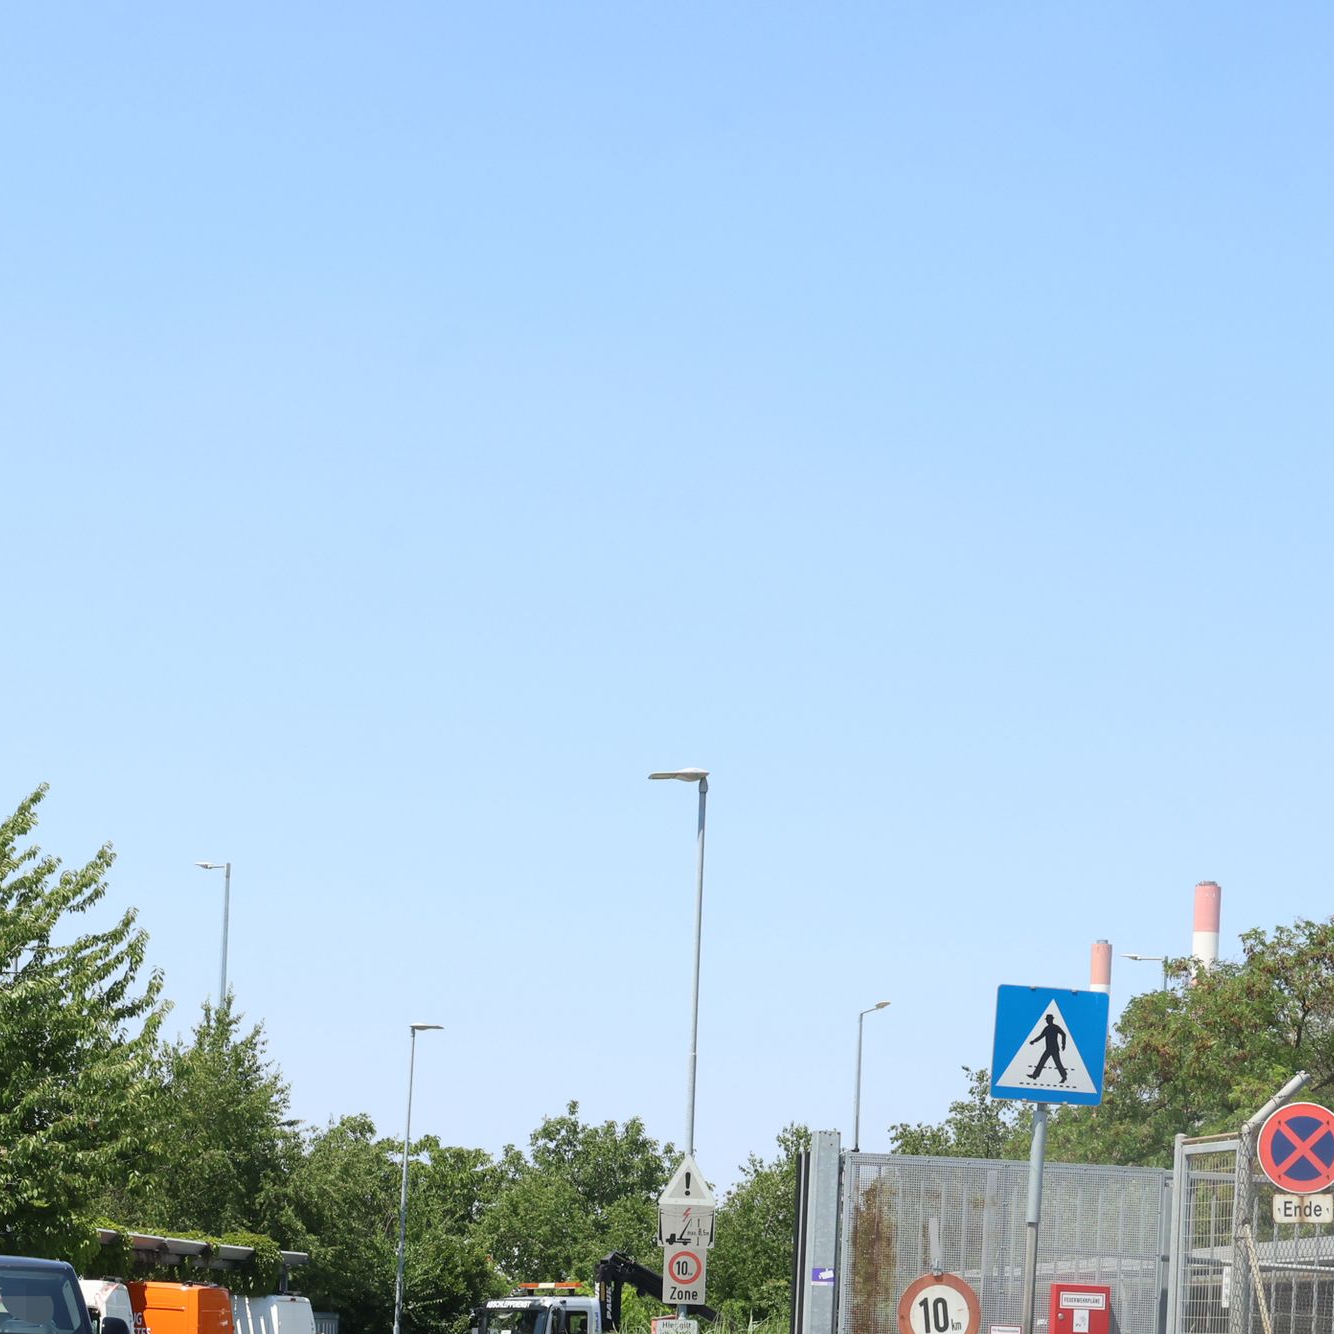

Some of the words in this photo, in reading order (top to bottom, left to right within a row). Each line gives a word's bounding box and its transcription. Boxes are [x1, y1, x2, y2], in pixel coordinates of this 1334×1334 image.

[1283, 1200, 1323, 1217] Ende
[676, 1260, 688, 1276] 10
[670, 1286, 698, 1300] Zone
[486, 1300, 532, 1308] ABSCHLEPPDIENST
[919, 1297, 950, 1334] 10
[951, 1319, 962, 1331] km
